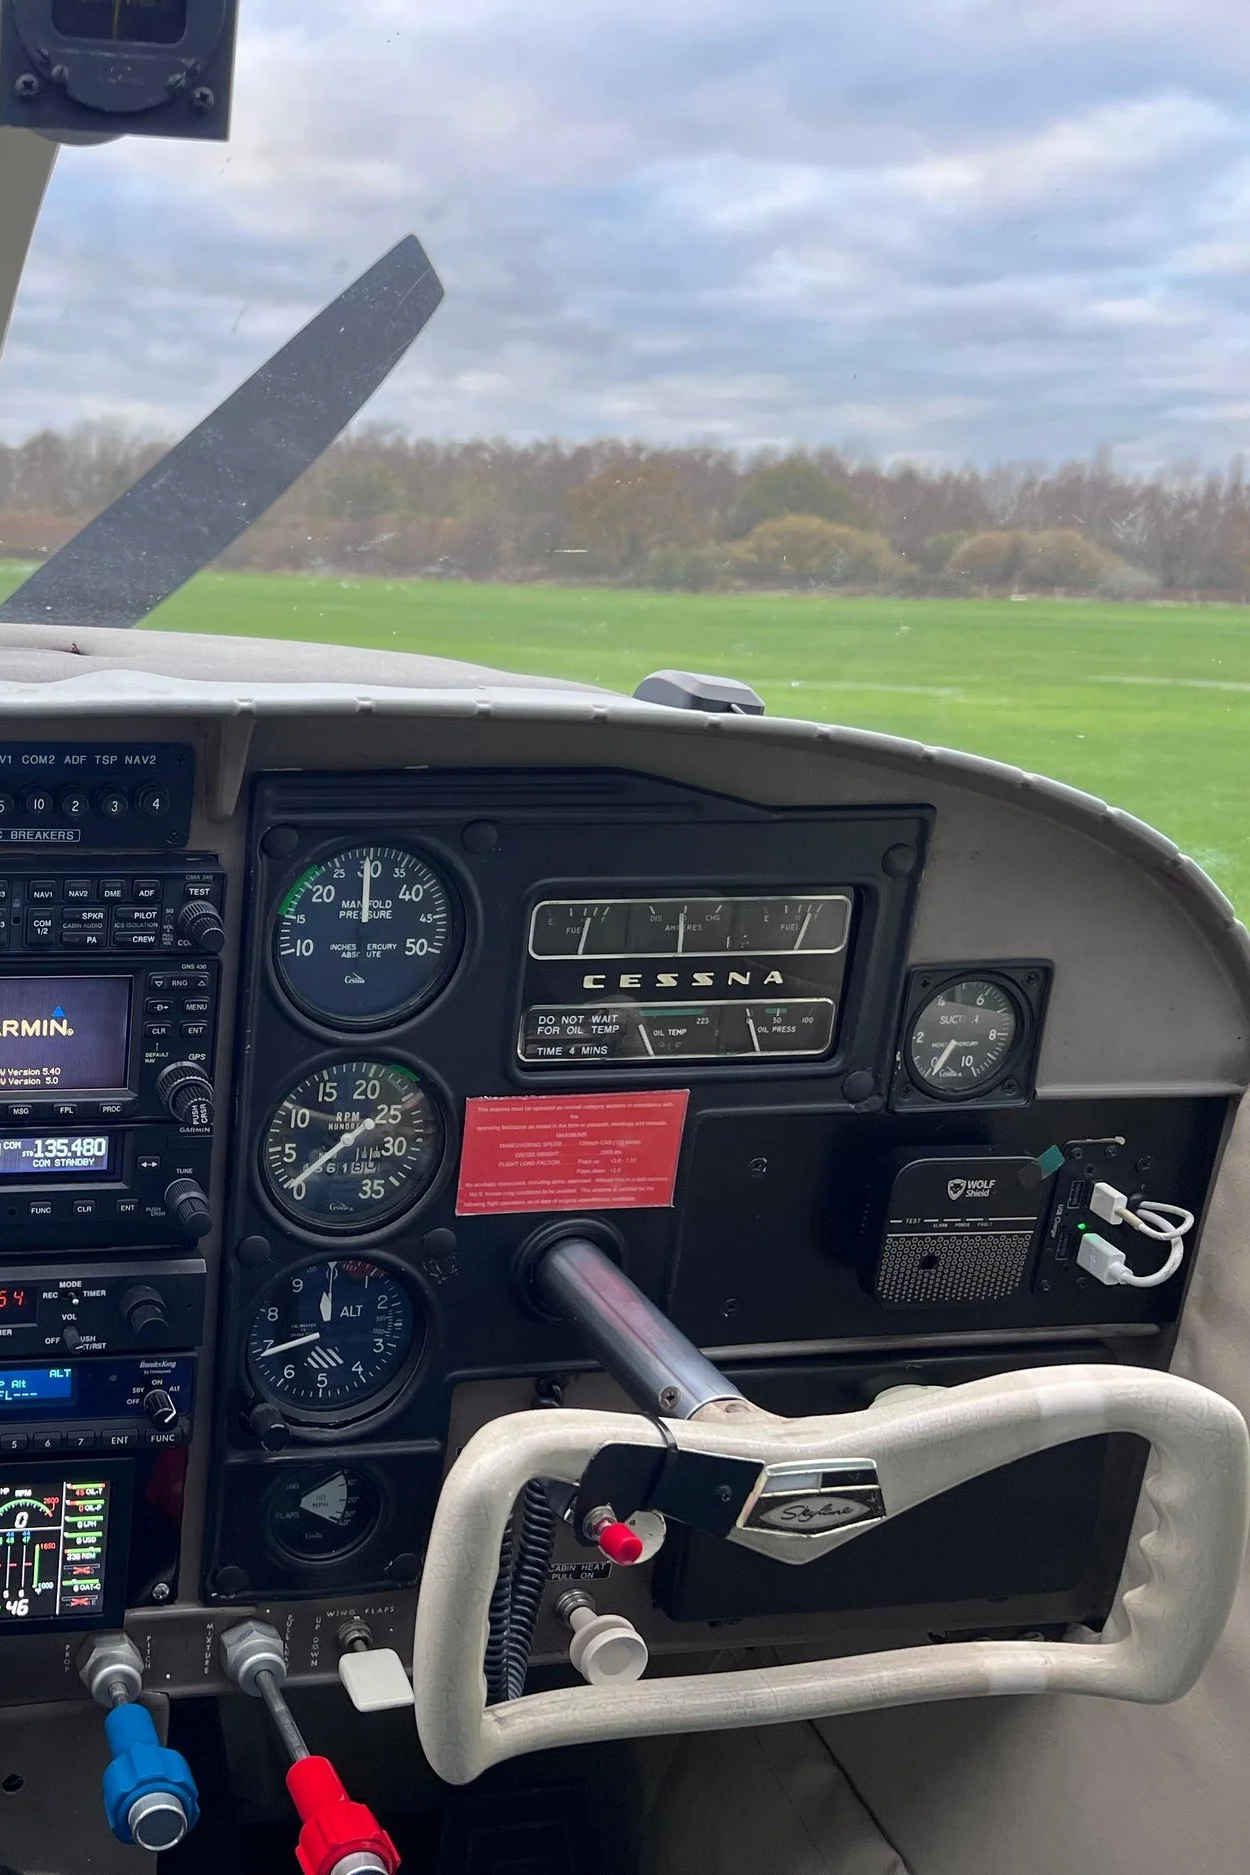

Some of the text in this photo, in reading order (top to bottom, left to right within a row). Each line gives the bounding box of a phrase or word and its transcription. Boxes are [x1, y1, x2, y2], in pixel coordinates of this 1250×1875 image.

[22, 755, 55, 764] COM2
[64, 756, 87, 764] ADF
[95, 756, 117, 764] TSP
[125, 756, 156, 764] NAV2
[11, 831, 74, 840] BREAKERS
[312, 885, 335, 902] 20
[399, 885, 424, 901] 40
[405, 939, 427, 955] 50
[583, 971, 783, 988] CESSNA
[539, 1014, 618, 1025] DO NOT WAIT
[537, 1024, 619, 1035] FOR OIL TEMP
[668, 1028, 687, 1036] TEMP
[537, 1047, 563, 1056] TIME
[581, 1046, 608, 1054] MINS
[8, 1068, 40, 1076] Version
[353, 1080, 380, 1100] 20
[336, 1112, 360, 1121] RPM
[34, 1138, 105, 1157] 135.480
[55, 1158, 94, 1166] STANDBY
[967, 1180, 995, 1189] WOLF
[965, 1189, 989, 1197] Shield
[340, 1305, 362, 1317] ALT
[50, 1369, 71, 1378] ALT
[151, 1434, 175, 1443] FUNC
[781, 1505, 853, 1520] Skylane
[582, 1563, 606, 1571] HEAT
[365, 1606, 394, 1614] FLAPS
